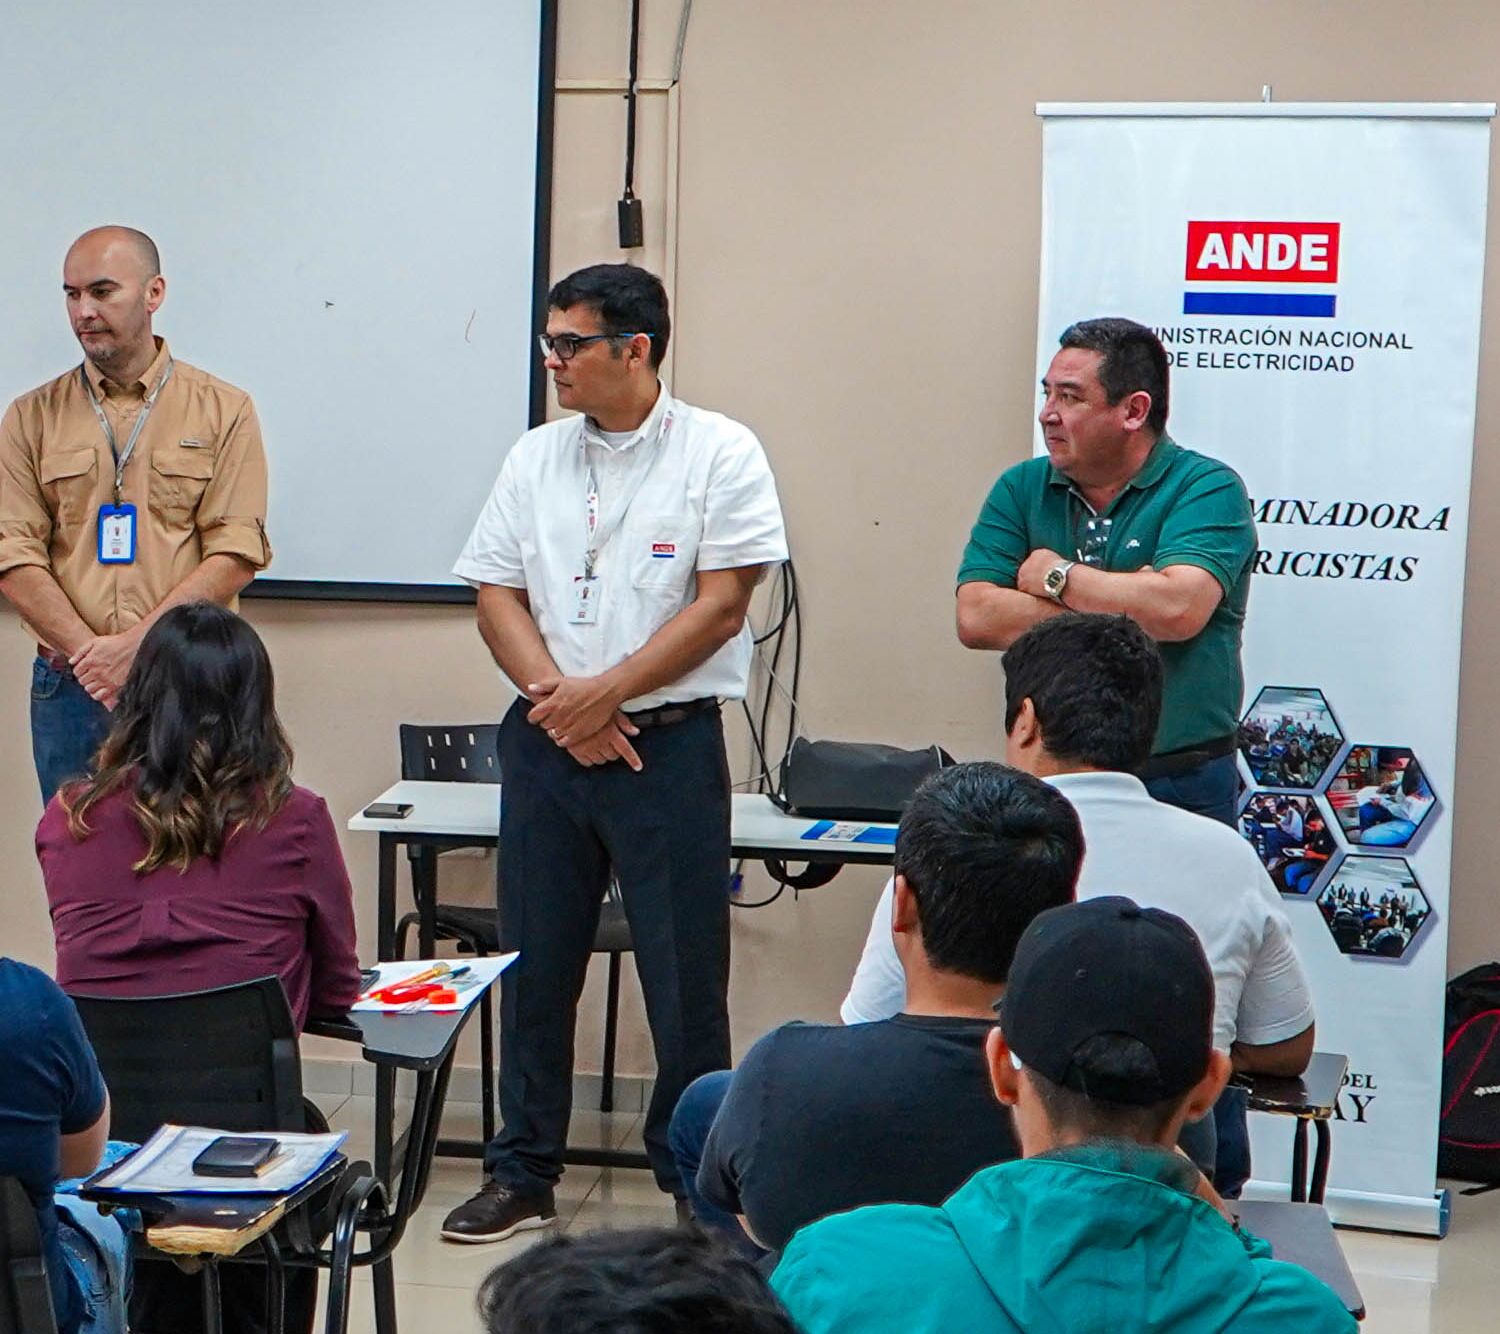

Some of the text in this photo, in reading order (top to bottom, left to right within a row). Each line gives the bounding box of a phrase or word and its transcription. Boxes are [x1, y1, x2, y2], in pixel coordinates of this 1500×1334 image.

[1196, 232, 1330, 271] ANDE
[1155, 325, 1414, 350] INISTRACIÓN NACIONAL
[1196, 352, 1355, 372] ELECTRICIDAD
[1249, 498, 1451, 532] MINADORA
[1250, 549, 1420, 582] RICISTAS
